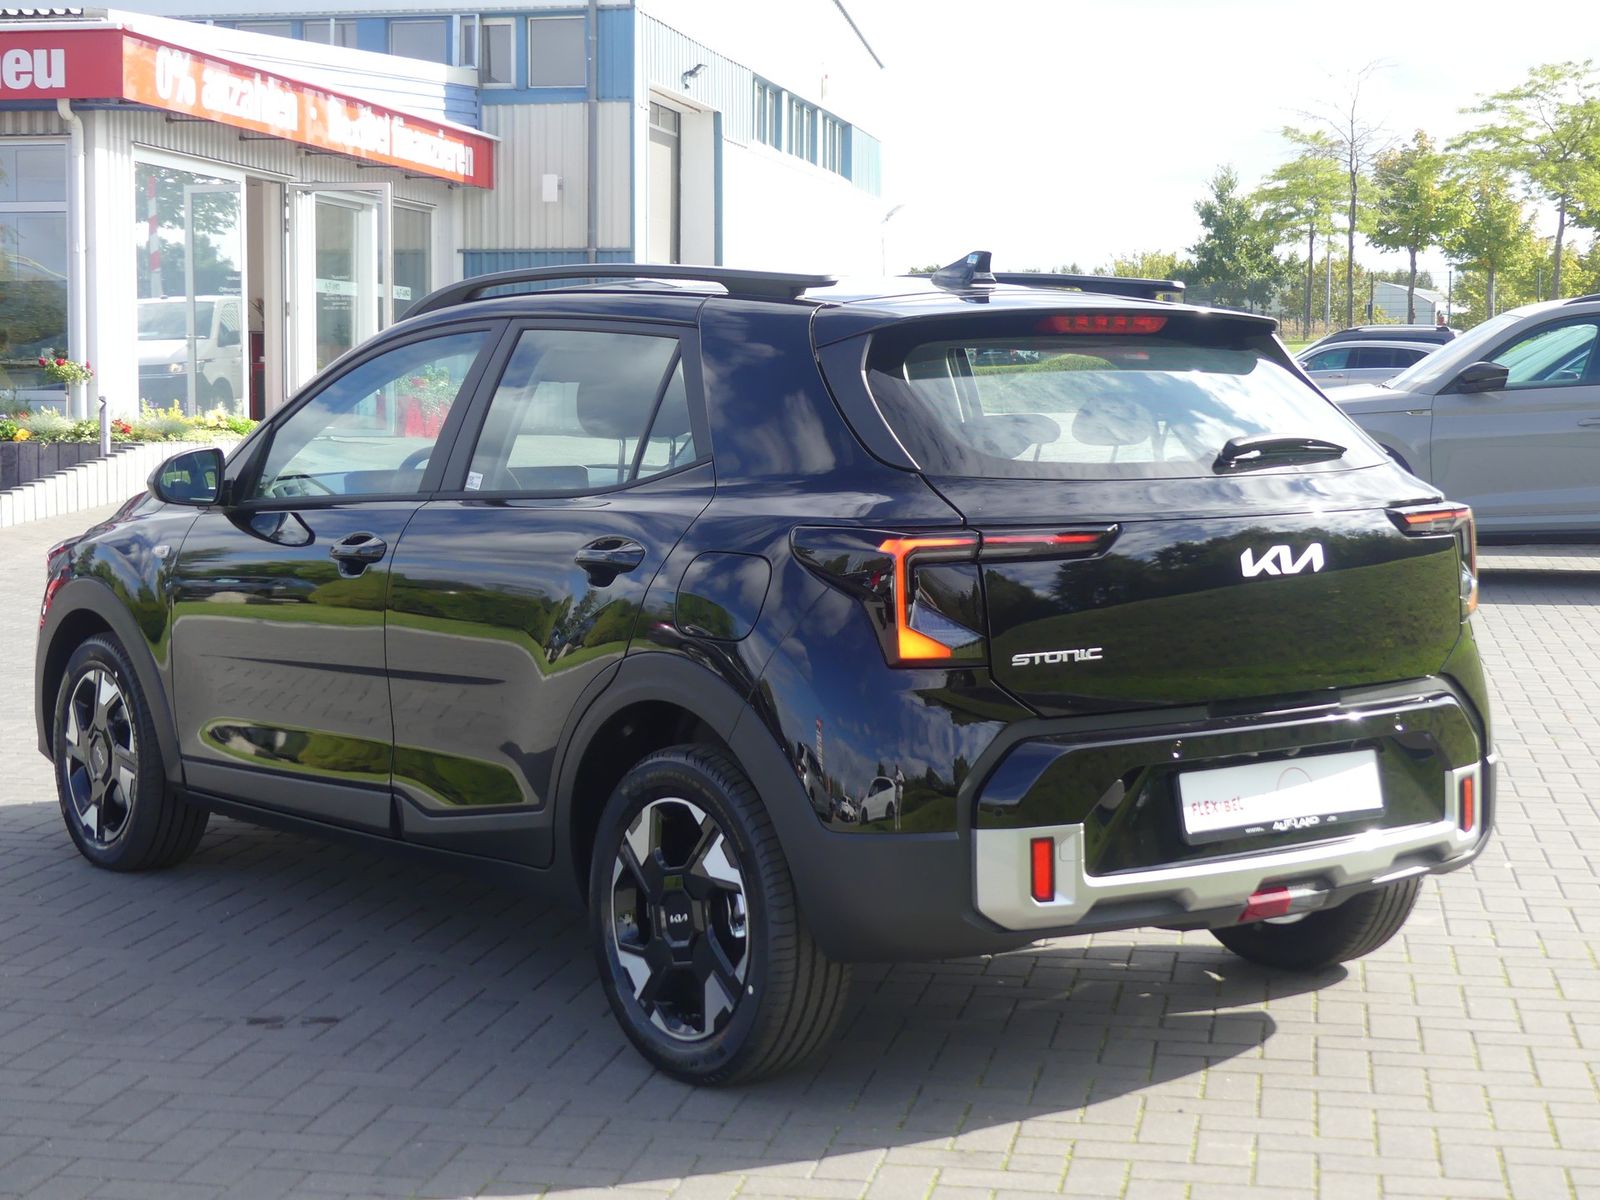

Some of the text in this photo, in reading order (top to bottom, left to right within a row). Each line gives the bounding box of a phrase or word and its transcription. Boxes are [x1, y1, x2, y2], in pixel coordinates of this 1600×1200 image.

[0, 48, 66, 90] eu
[155, 45, 197, 106] 0%
[1240, 542, 1325, 577] KIA
[1011, 647, 1103, 666] STONIC
